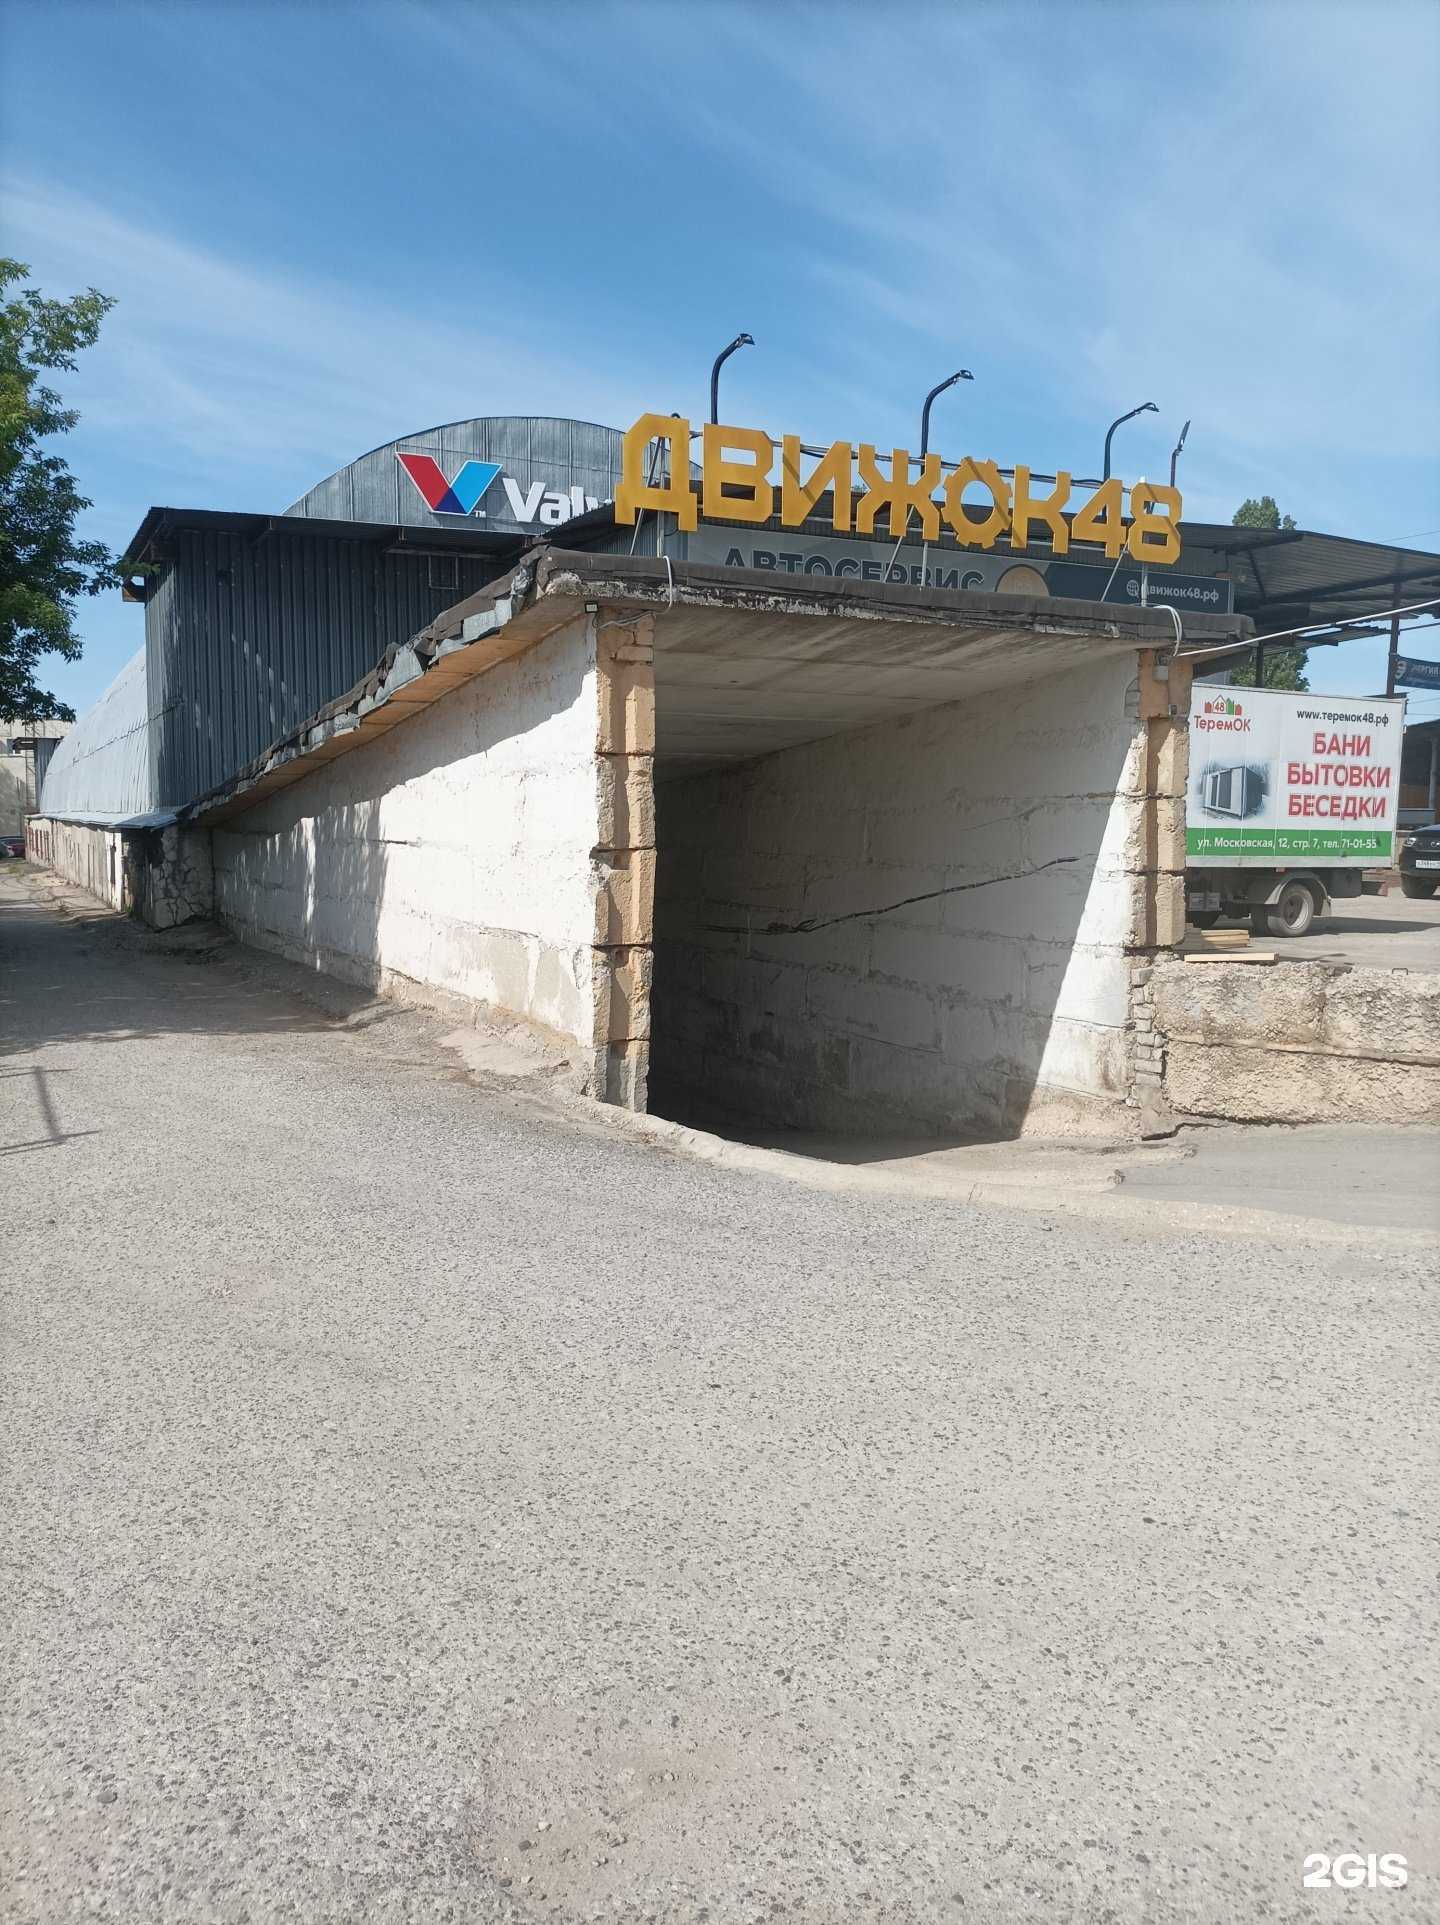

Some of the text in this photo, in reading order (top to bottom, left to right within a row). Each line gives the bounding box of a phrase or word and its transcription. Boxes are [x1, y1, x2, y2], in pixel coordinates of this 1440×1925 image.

[614, 413, 1182, 565] ДВИЖОК48
[724, 547, 985, 589] АВТОСЕРВИС
[1214, 702, 1225, 712] 48
[1297, 709, 1389, 727] www.теремок48.рф
[1313, 732, 1370, 756] БАНИ
[1287, 762, 1390, 787] БЫТОВКИ
[1288, 794, 1386, 820] БЕСЕДКИ
[1197, 838, 1212, 850] ул.
[1214, 837, 1276, 849] Московская,
[1278, 838, 1290, 849] 12,
[1341, 839, 1377, 849] 71-01-55
